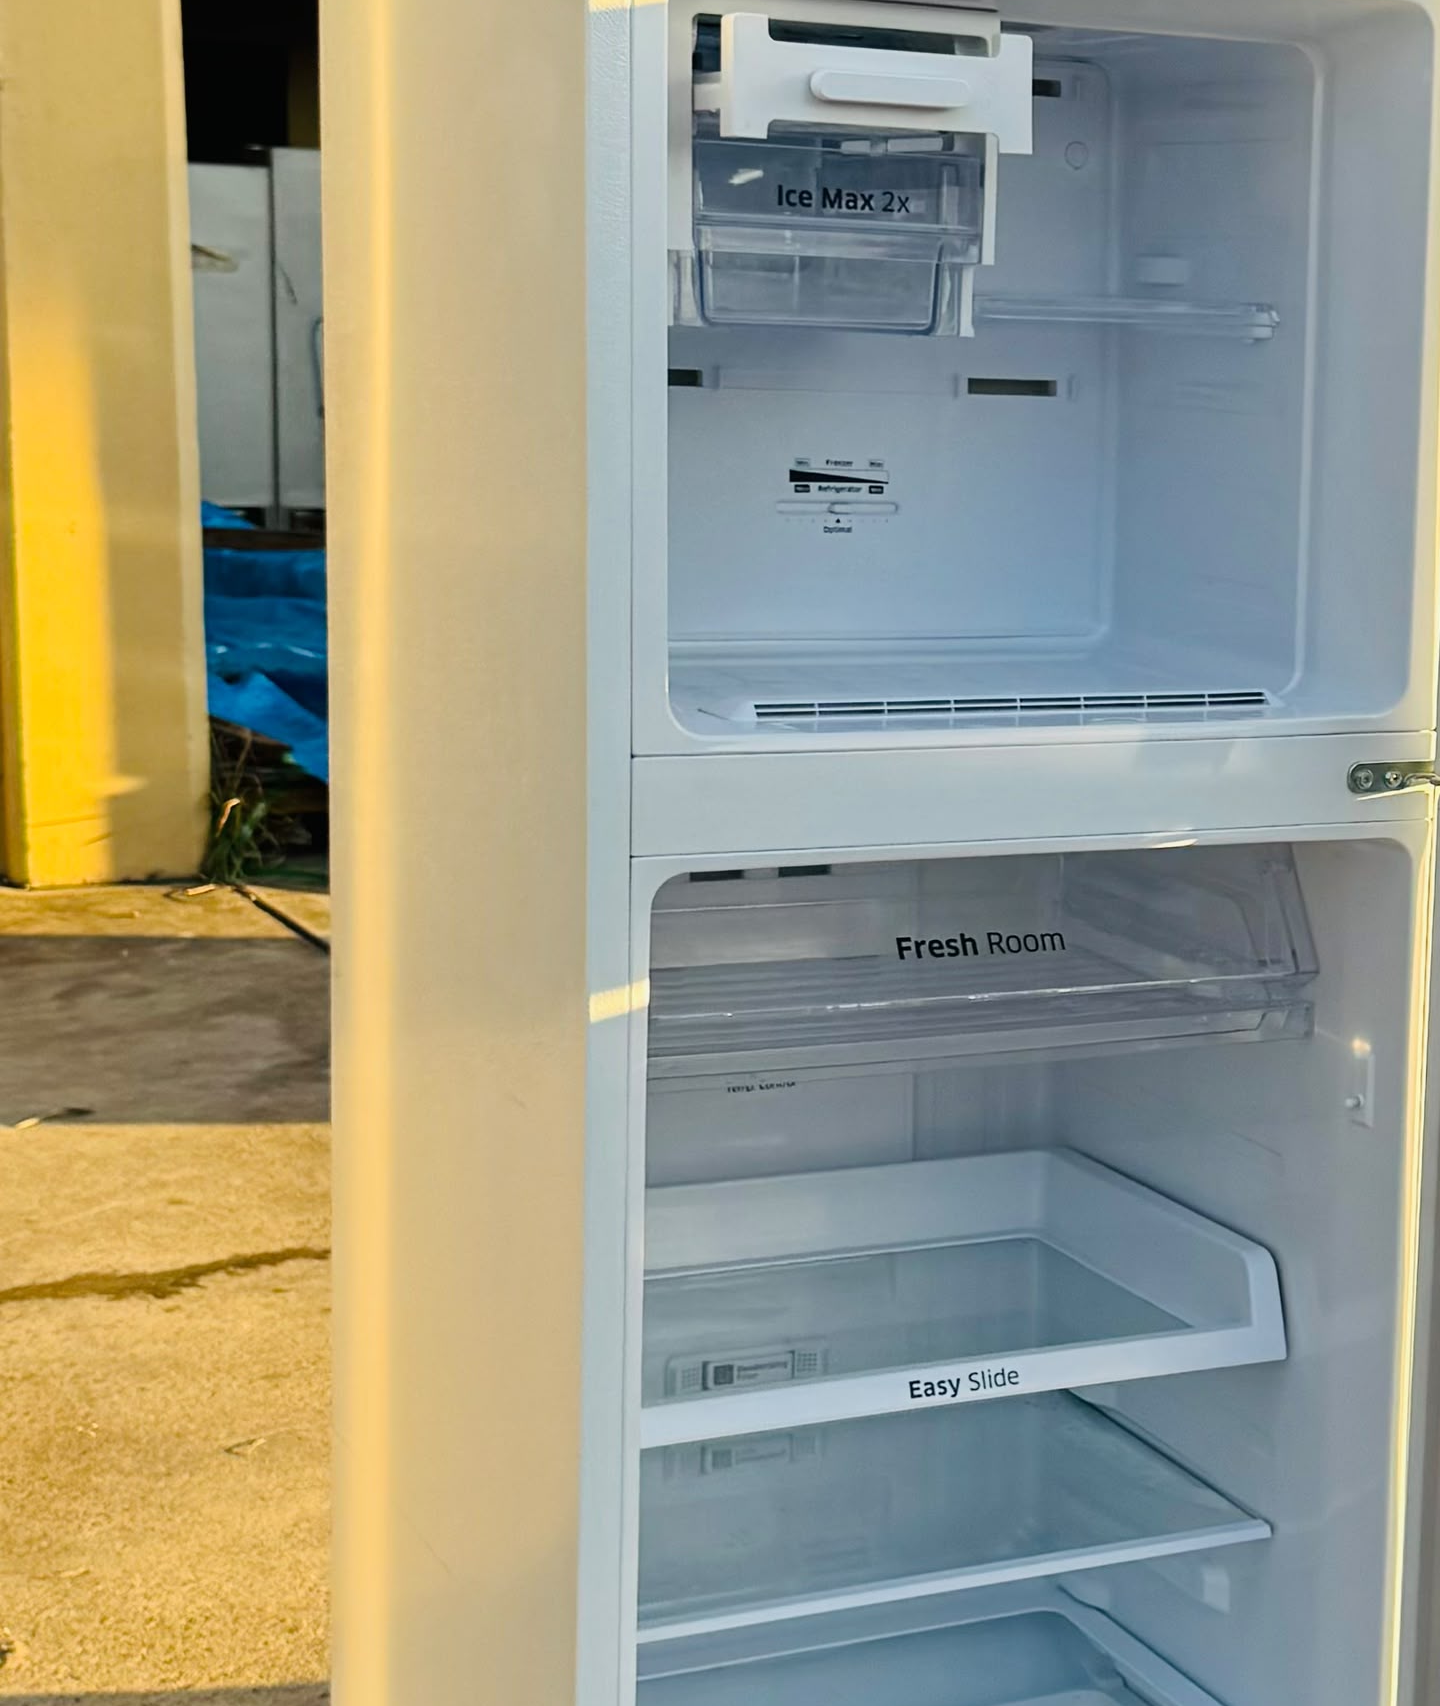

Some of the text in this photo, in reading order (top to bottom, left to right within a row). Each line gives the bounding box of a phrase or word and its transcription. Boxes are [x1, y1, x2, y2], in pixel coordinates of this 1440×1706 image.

[777, 184, 910, 213] Ice Max 2x
[818, 485, 862, 493] Refrigerator
[823, 526, 852, 534] Optimal
[896, 932, 1066, 960] Fresh Room
[908, 1367, 1020, 1399] Easy Slide
